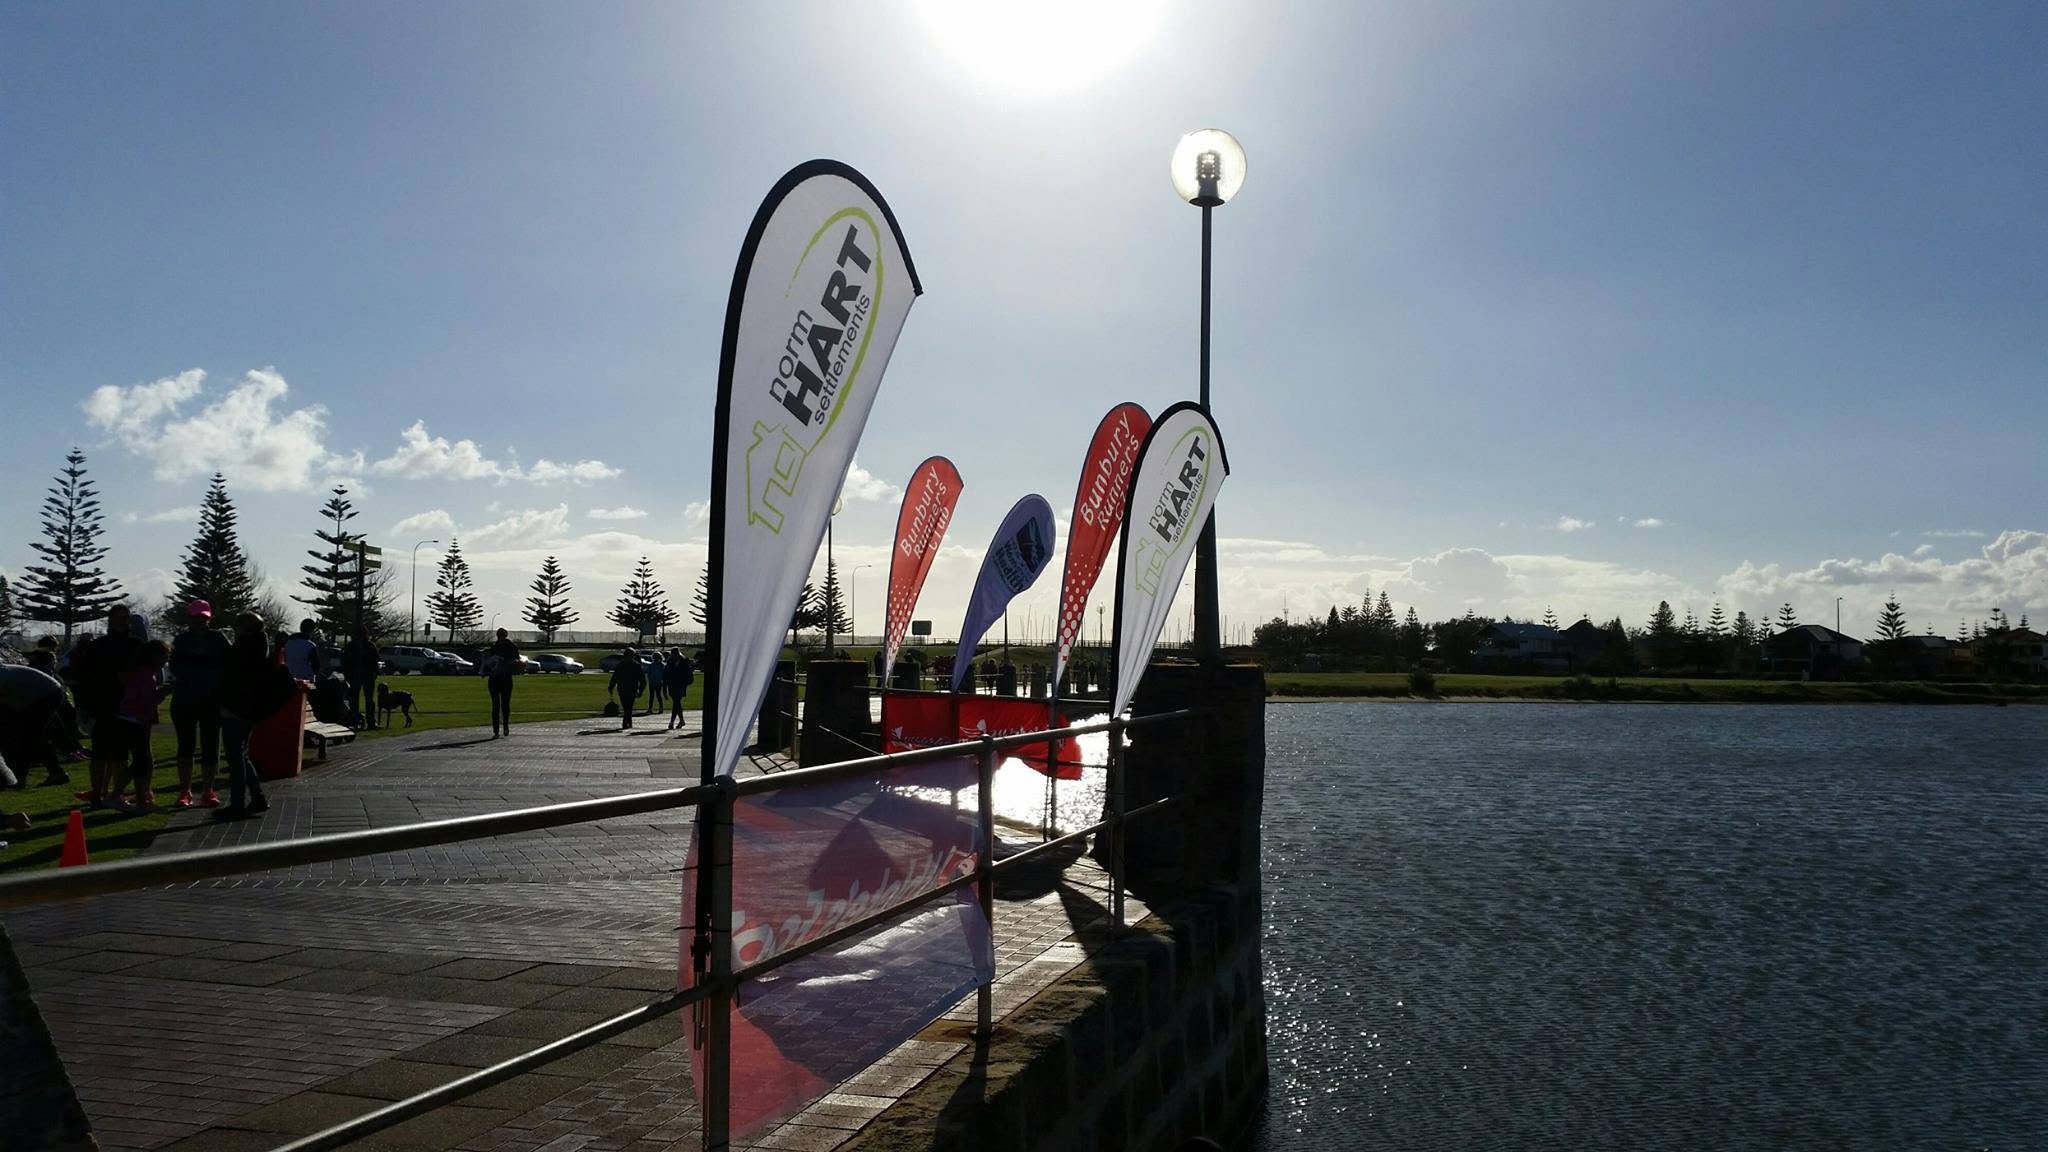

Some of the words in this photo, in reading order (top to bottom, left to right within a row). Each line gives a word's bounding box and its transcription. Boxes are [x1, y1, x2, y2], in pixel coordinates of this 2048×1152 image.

[769, 309, 813, 403] norm
[782, 224, 871, 426] HART
[814, 295, 870, 425] settlements
[900, 465, 939, 557] Bunbury
[1080, 411, 1130, 526] Bunbury
[1098, 434, 1139, 531] Runners
[1149, 481, 1174, 530] norm
[1156, 436, 1205, 543] HART
[1172, 473, 1203, 543] settlements
[913, 481, 947, 560] Runners
